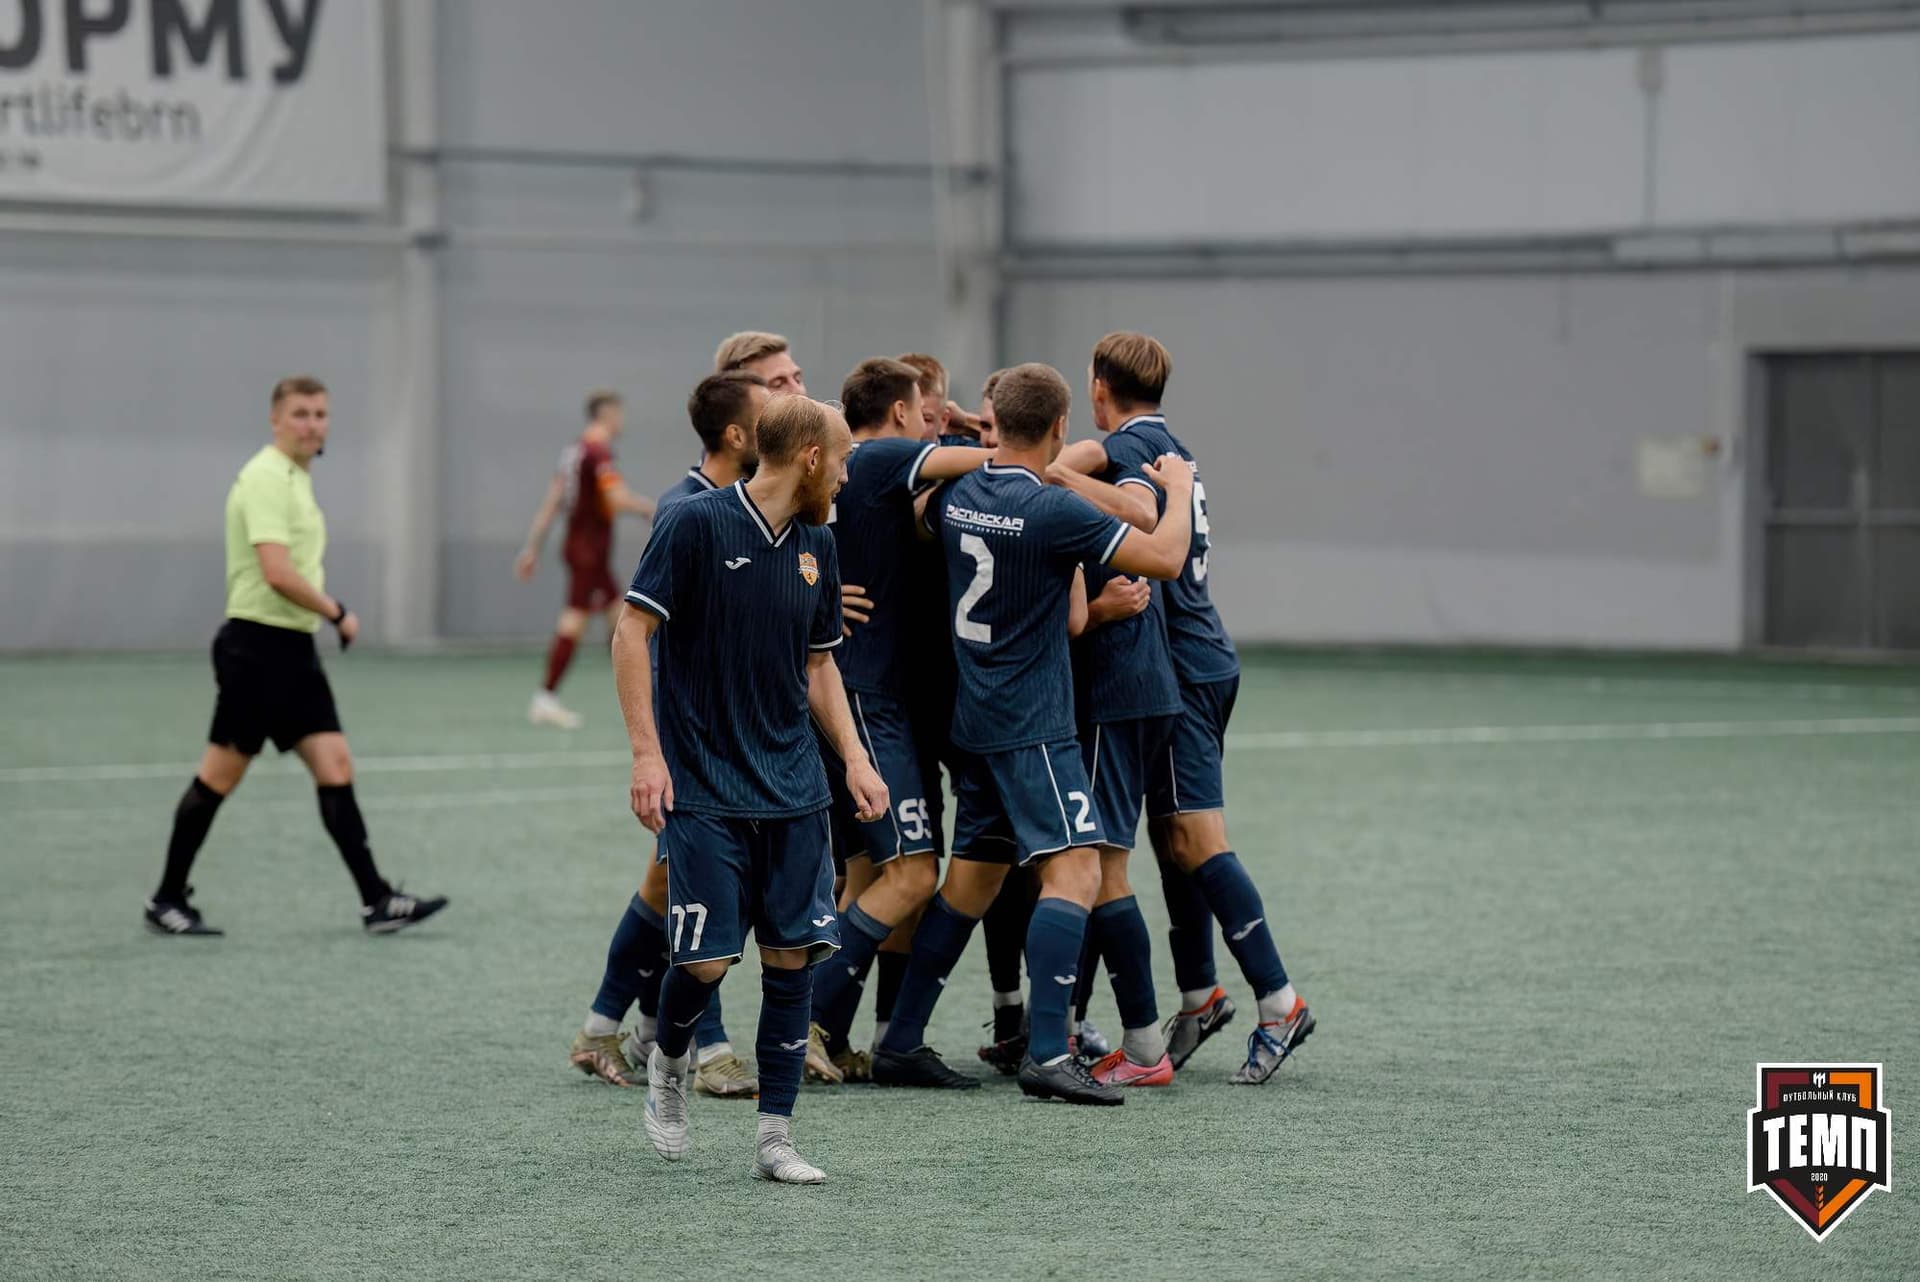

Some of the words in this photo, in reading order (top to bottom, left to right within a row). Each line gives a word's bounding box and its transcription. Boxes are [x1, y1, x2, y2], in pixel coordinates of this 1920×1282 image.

[955, 532, 995, 644] 2
[1068, 791, 1096, 833] 2
[671, 903, 708, 953] 77
